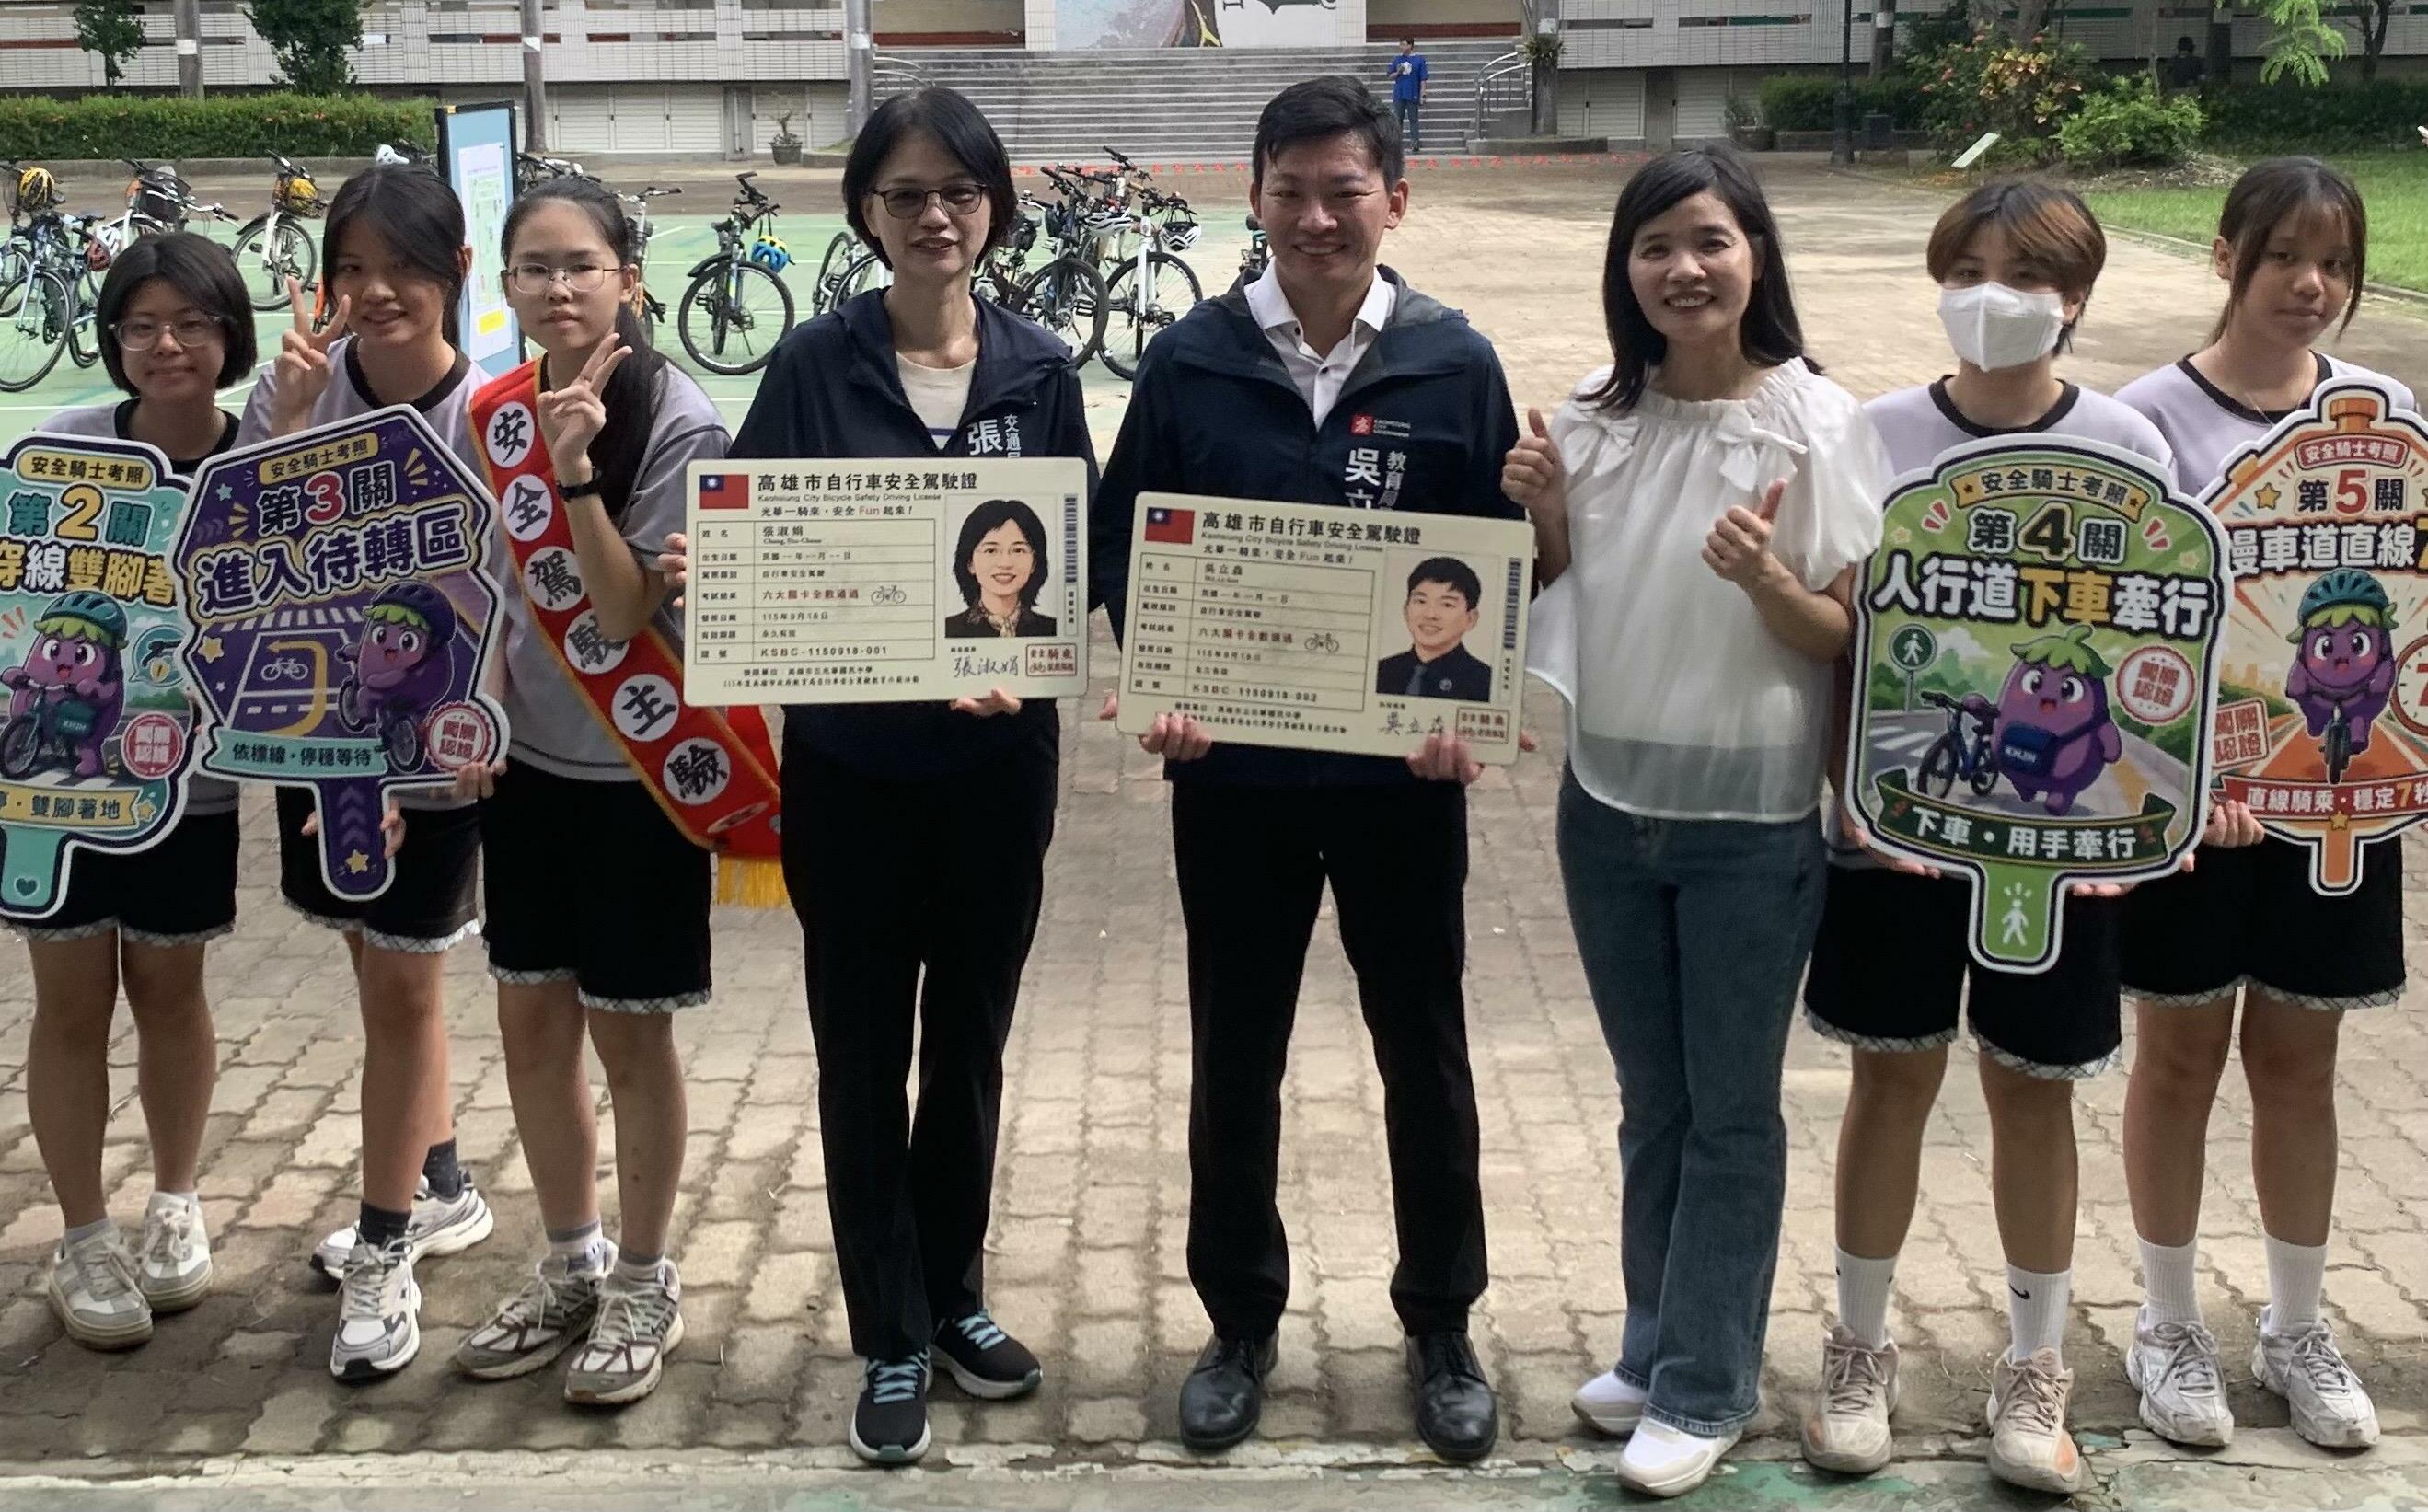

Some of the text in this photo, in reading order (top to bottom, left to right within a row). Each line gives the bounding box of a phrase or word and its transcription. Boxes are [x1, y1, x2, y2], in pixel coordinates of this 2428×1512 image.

[968, 418, 1004, 456] 張
[2304, 441, 2399, 463] 安全騎士考照
[31, 456, 144, 484] 安全騎士考照
[271, 439, 367, 479] 安全騎士考照
[259, 462, 395, 535] 第3關
[757, 473, 978, 492] 高雄市自行車安全駕駛證
[803, 494, 820, 502] City
[855, 493, 880, 502] Safety
[883, 492, 911, 502] Driving
[1981, 468, 2130, 506] 安全騎士考照
[2297, 469, 2405, 514] 第5關
[8, 483, 153, 547] 第2關
[859, 506, 880, 515] Fun
[1202, 510, 1421, 545] 高雄市自行車安全駕駛證
[1971, 502, 2123, 560] 第4關
[196, 508, 467, 614] 進入待轉區
[1299, 552, 1320, 561] Fun
[1873, 553, 2209, 636] 人行道下車牽行
